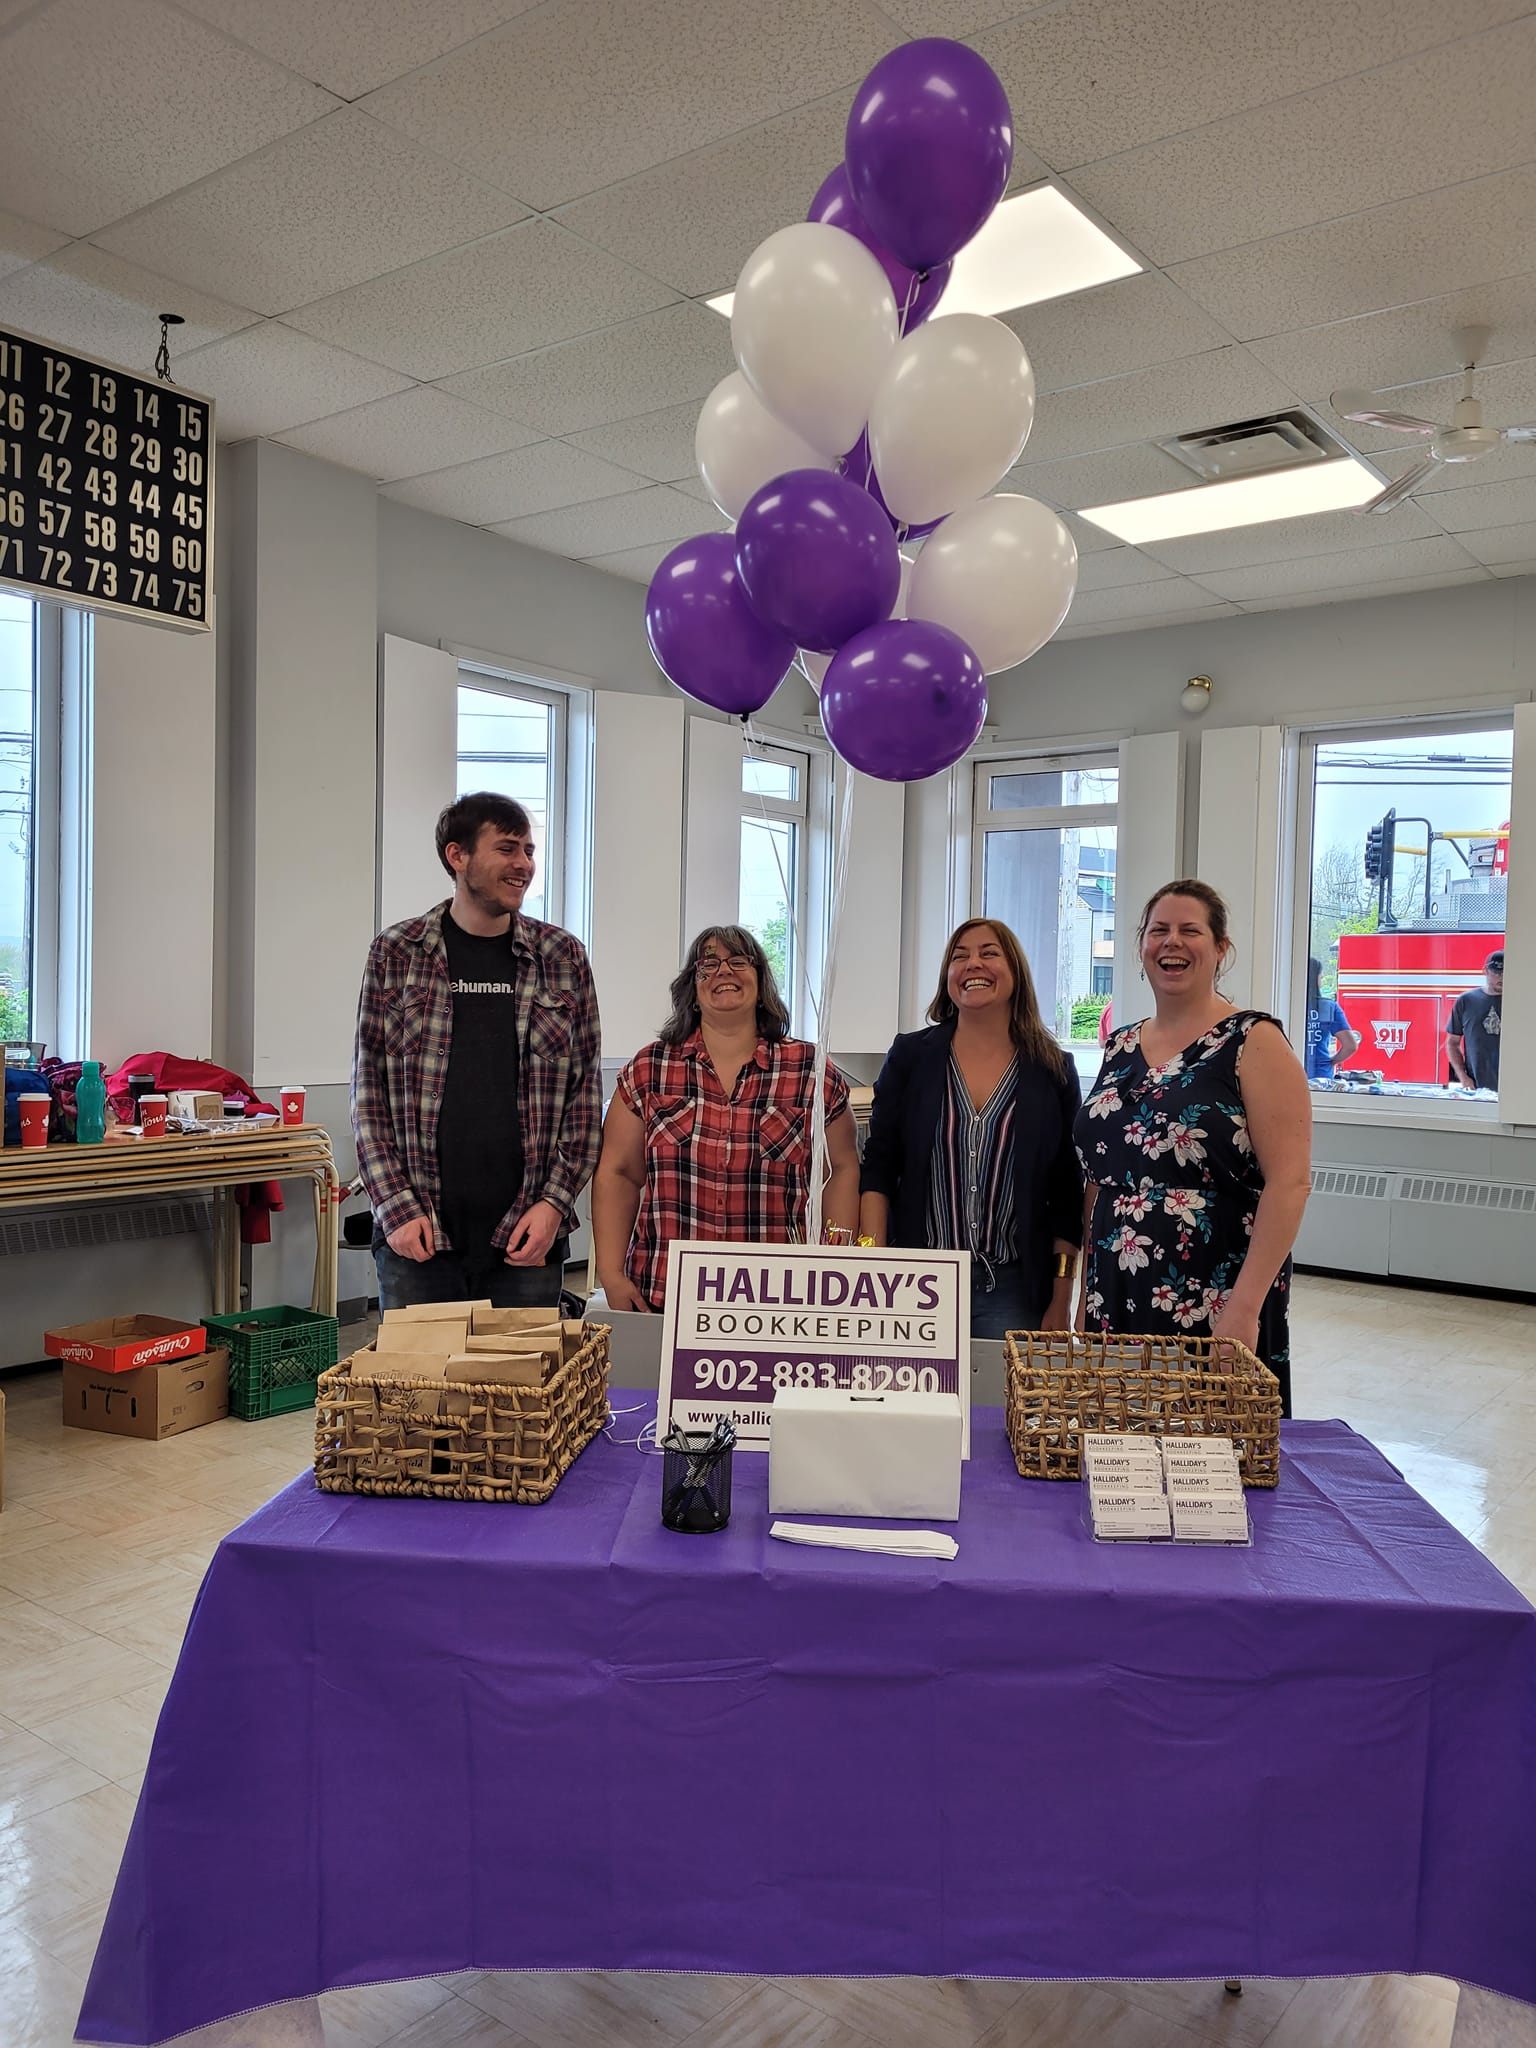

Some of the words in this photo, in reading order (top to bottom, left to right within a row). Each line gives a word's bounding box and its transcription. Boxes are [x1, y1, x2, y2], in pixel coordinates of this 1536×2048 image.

[0, 340, 22, 382] 11
[43, 357, 71, 400] 12
[90, 373, 117, 414] 13
[134, 388, 160, 428] 14
[177, 403, 201, 441] 15
[38, 403, 72, 445] 27
[85, 418, 117, 460] 28
[130, 433, 161, 473] 29
[173, 446, 202, 486] 30
[37, 452, 72, 495] 42
[84, 466, 117, 506] 43
[129, 479, 161, 519] 44
[172, 492, 202, 530] 45
[38, 498, 72, 539] 57
[84, 511, 117, 552] 58
[130, 523, 160, 563] 59
[172, 535, 201, 573] 60
[38, 544, 72, 587] 72
[85, 557, 118, 598] 73
[130, 568, 160, 607] 74
[172, 578, 201, 617] 75
[1379, 1028, 1404, 1043] 911
[143, 1115, 164, 1128] tons
[697, 1266, 940, 1310] HALLIDAY'S
[696, 1313, 937, 1341] BOOKKEEPING
[133, 1335, 191, 1365] Crimson
[693, 1358, 940, 1392] 902-883-8290
[1088, 1438, 1124, 1446] HALLIDAY'S
[1165, 1441, 1201, 1449] HALLIDAY'S
[1094, 1458, 1130, 1466] HALLIDAY'S
[1093, 1475, 1129, 1483] HALLIDAY'S
[1173, 1478, 1209, 1486] HALLIDAY'S
[1098, 1498, 1136, 1506] HALLIDAY'S
[1176, 1500, 1213, 1509] HALLIDAY'S
